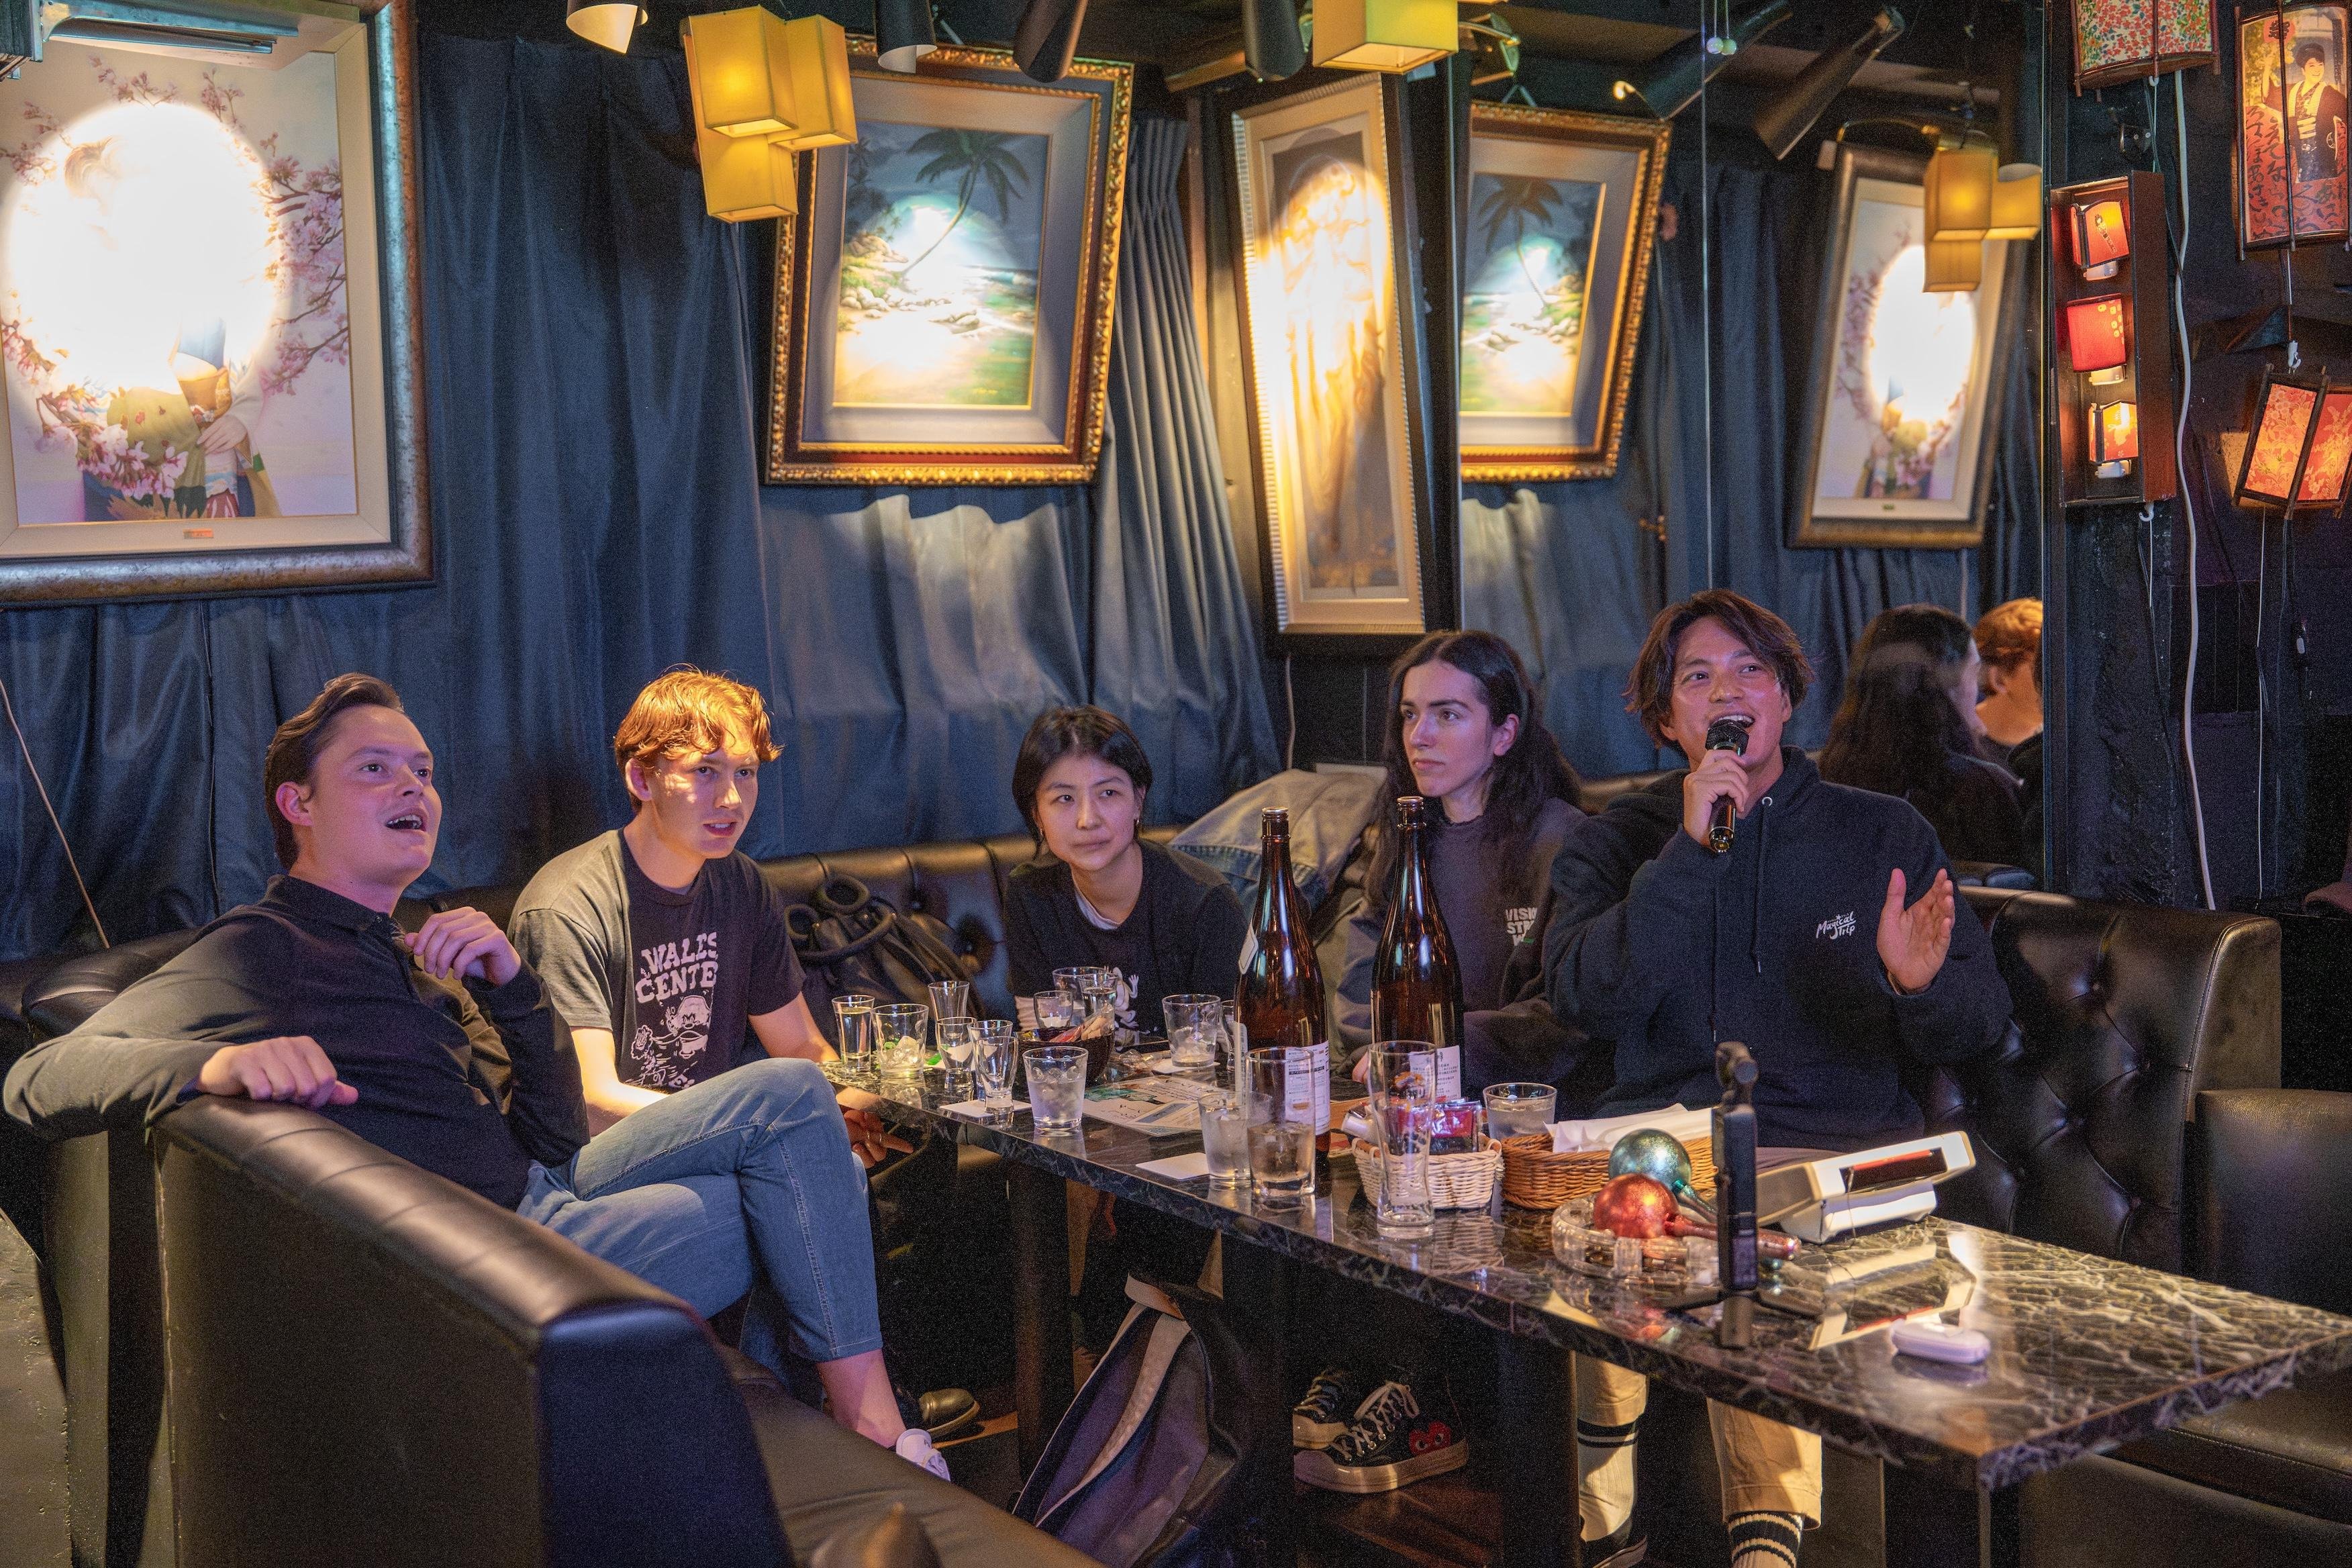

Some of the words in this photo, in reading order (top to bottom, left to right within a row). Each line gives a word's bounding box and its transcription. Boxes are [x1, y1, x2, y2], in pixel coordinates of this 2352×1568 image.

[1816, 911, 1854, 940] Magical
[1837, 920, 1857, 936] Trip
[635, 961, 719, 1003] CENTE
